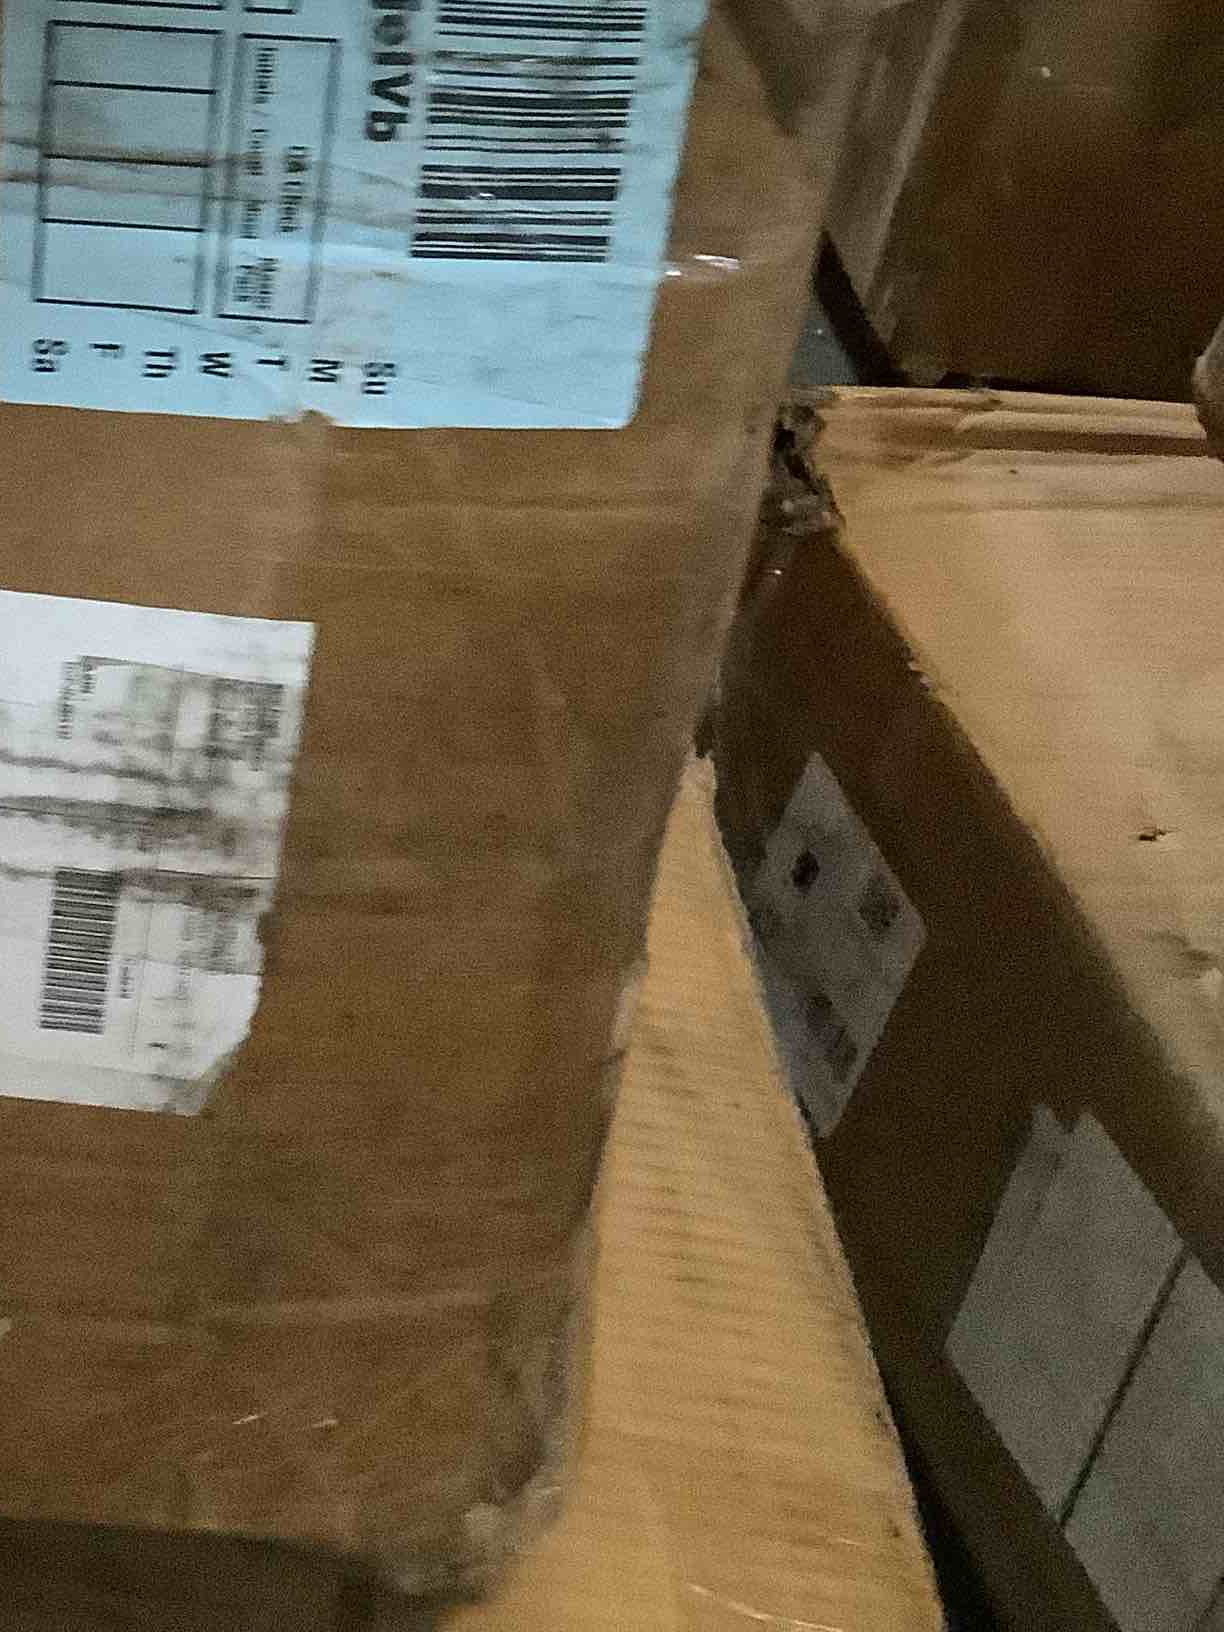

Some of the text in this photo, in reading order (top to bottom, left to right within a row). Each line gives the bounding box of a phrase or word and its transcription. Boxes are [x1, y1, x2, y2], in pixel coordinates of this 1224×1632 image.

[141, 348, 179, 379] Th
[197, 352, 233, 378] W
[307, 358, 343, 383] M
